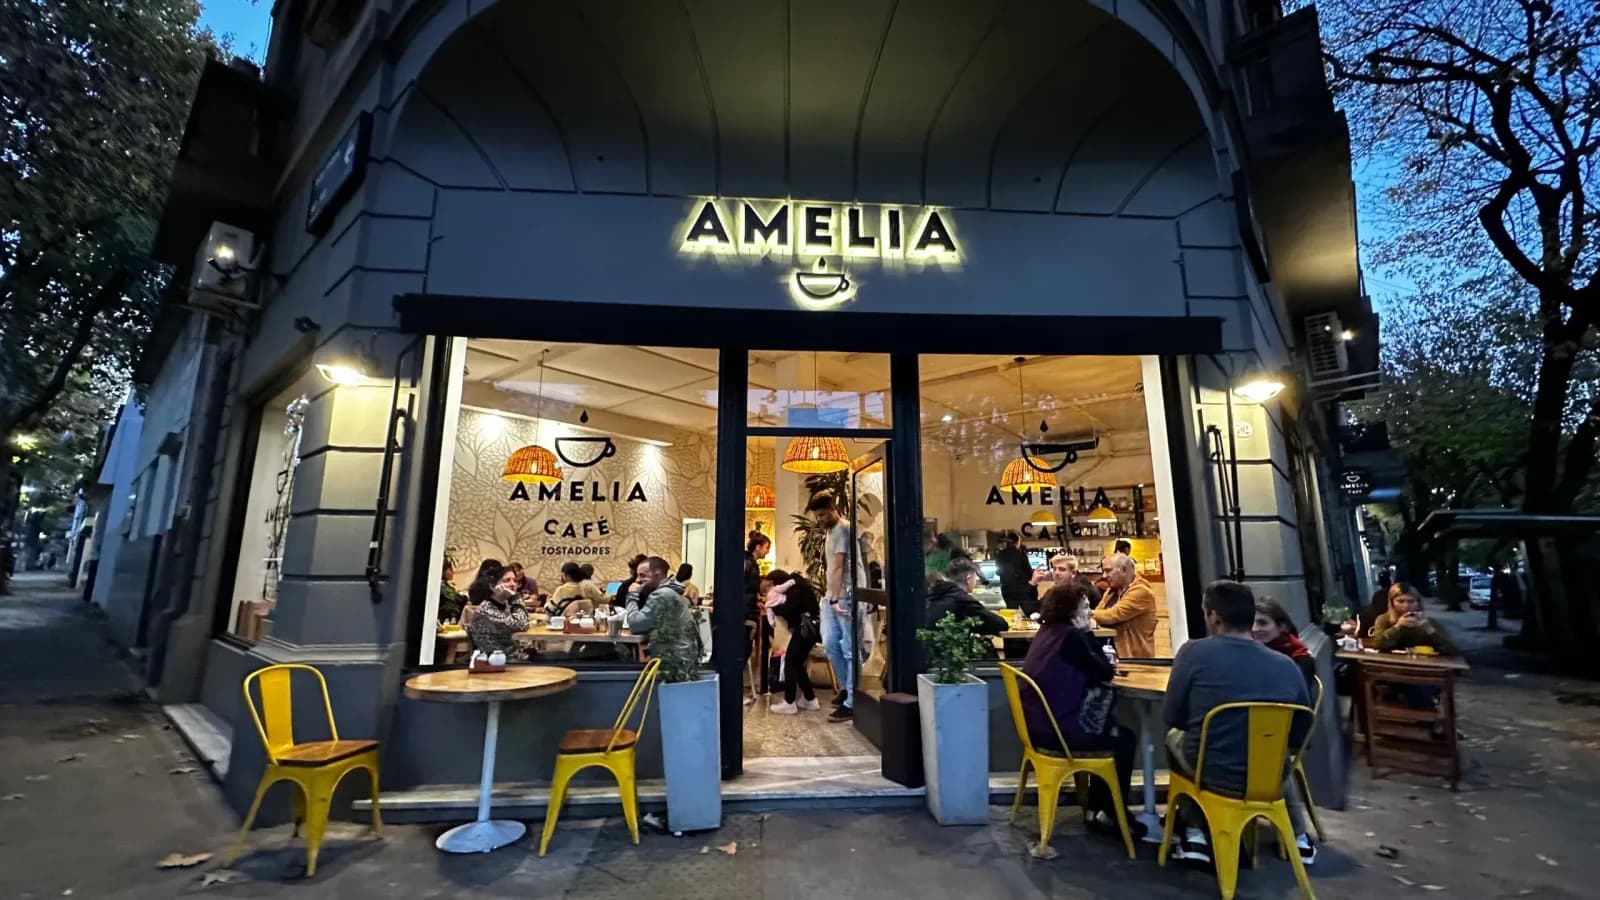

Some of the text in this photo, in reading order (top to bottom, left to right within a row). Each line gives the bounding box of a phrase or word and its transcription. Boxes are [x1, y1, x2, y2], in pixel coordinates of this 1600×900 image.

[686, 201, 957, 252] AMELIA
[509, 480, 647, 502] AMELIA
[986, 485, 1111, 507] AMELIA
[544, 515, 610, 538] CAFÉ
[541, 546, 611, 555] TOSTADORES
